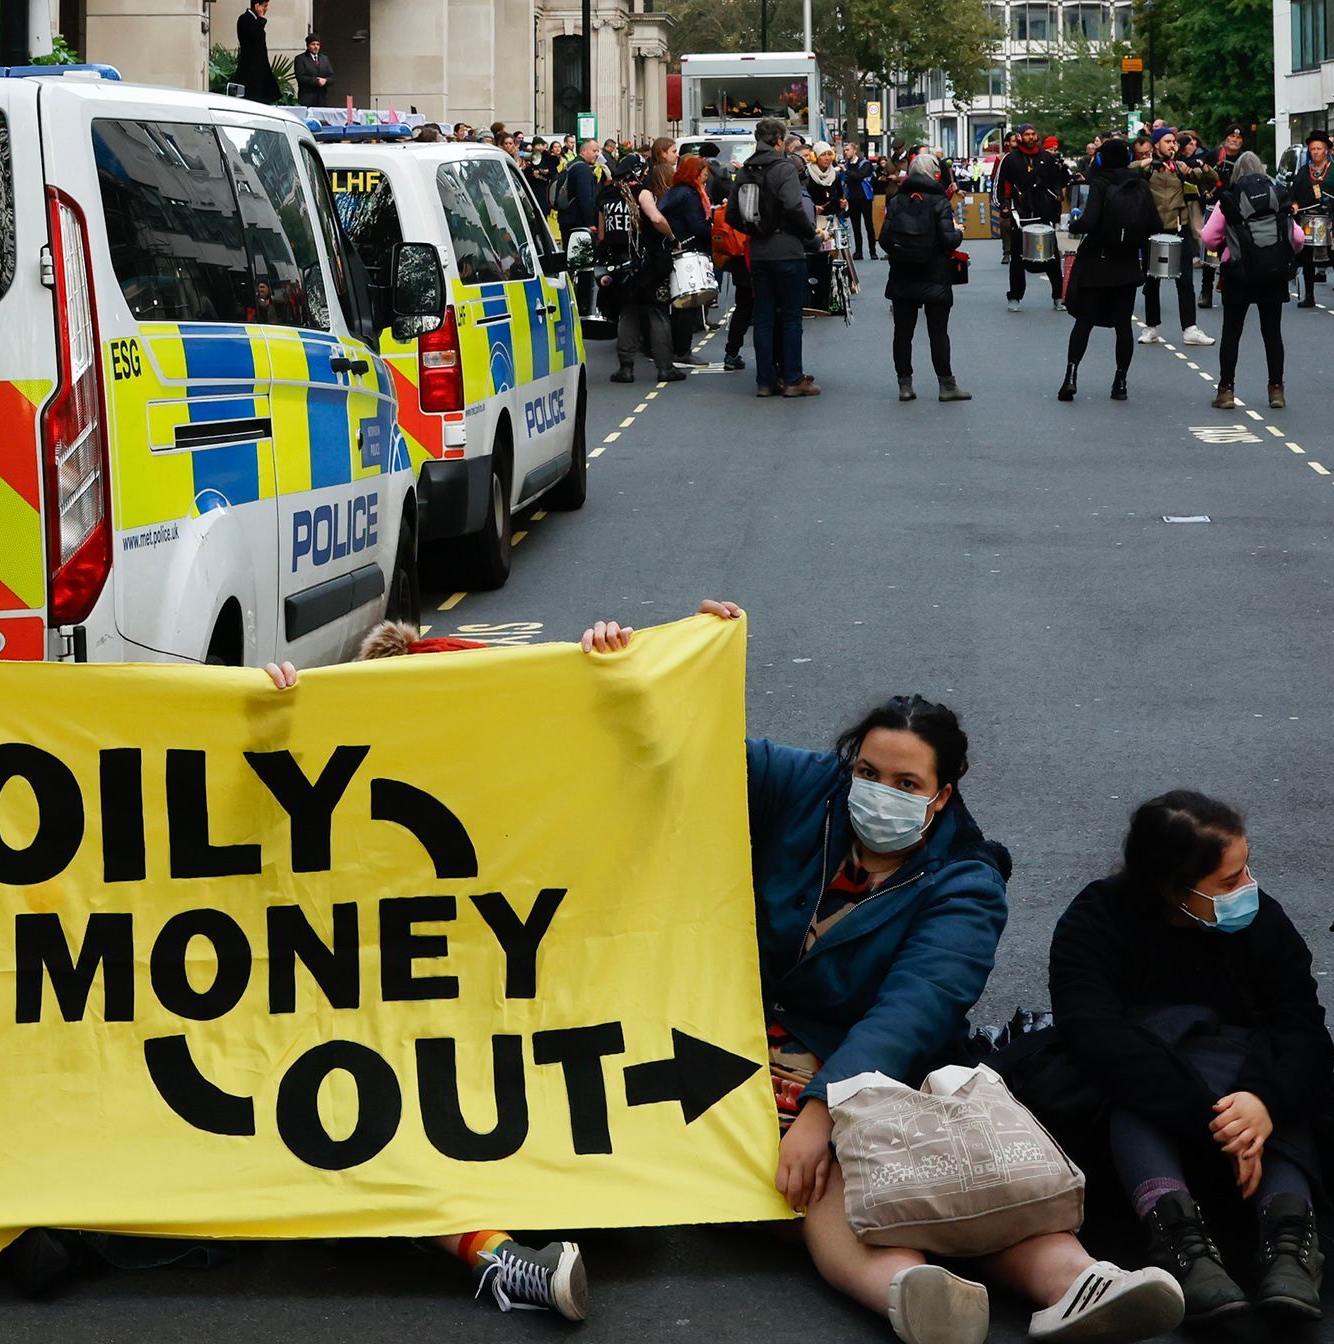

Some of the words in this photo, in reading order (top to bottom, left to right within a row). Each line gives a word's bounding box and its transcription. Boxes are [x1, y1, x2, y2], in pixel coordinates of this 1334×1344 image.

[332, 172, 380, 192] LHF
[110, 339, 142, 381] ESG
[525, 388, 566, 438] POLICE
[122, 522, 179, 552] www.met.police.uk
[291, 492, 378, 573] POLICE
[14, 887, 568, 1023] MONEY
[275, 1021, 626, 1171] OUT
